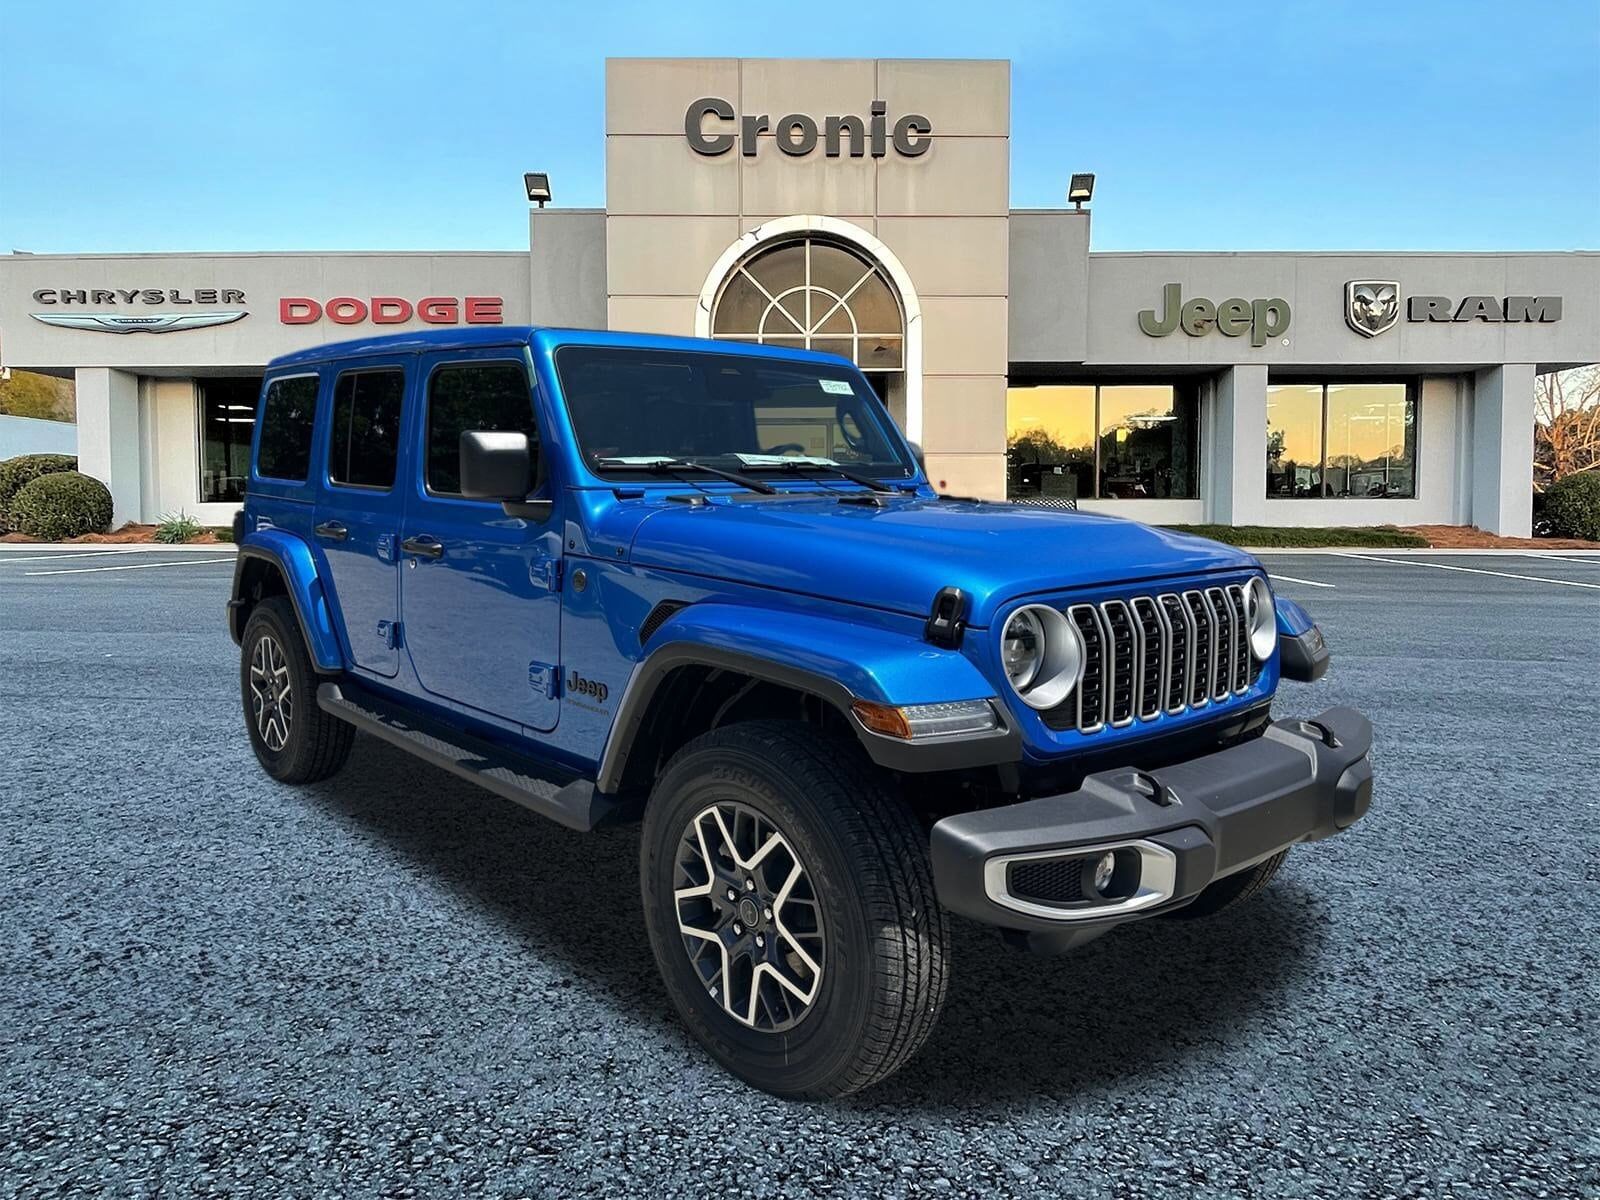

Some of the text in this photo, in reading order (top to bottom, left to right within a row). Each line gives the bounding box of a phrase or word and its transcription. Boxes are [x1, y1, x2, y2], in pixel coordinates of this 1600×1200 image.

[685, 97, 932, 157] Cronic
[32, 288, 247, 304] CHRYSLER
[279, 297, 503, 324] DODGE
[1407, 296, 1562, 322] RAM
[1138, 283, 1291, 347] Jeep
[566, 670, 608, 703] Jeep
